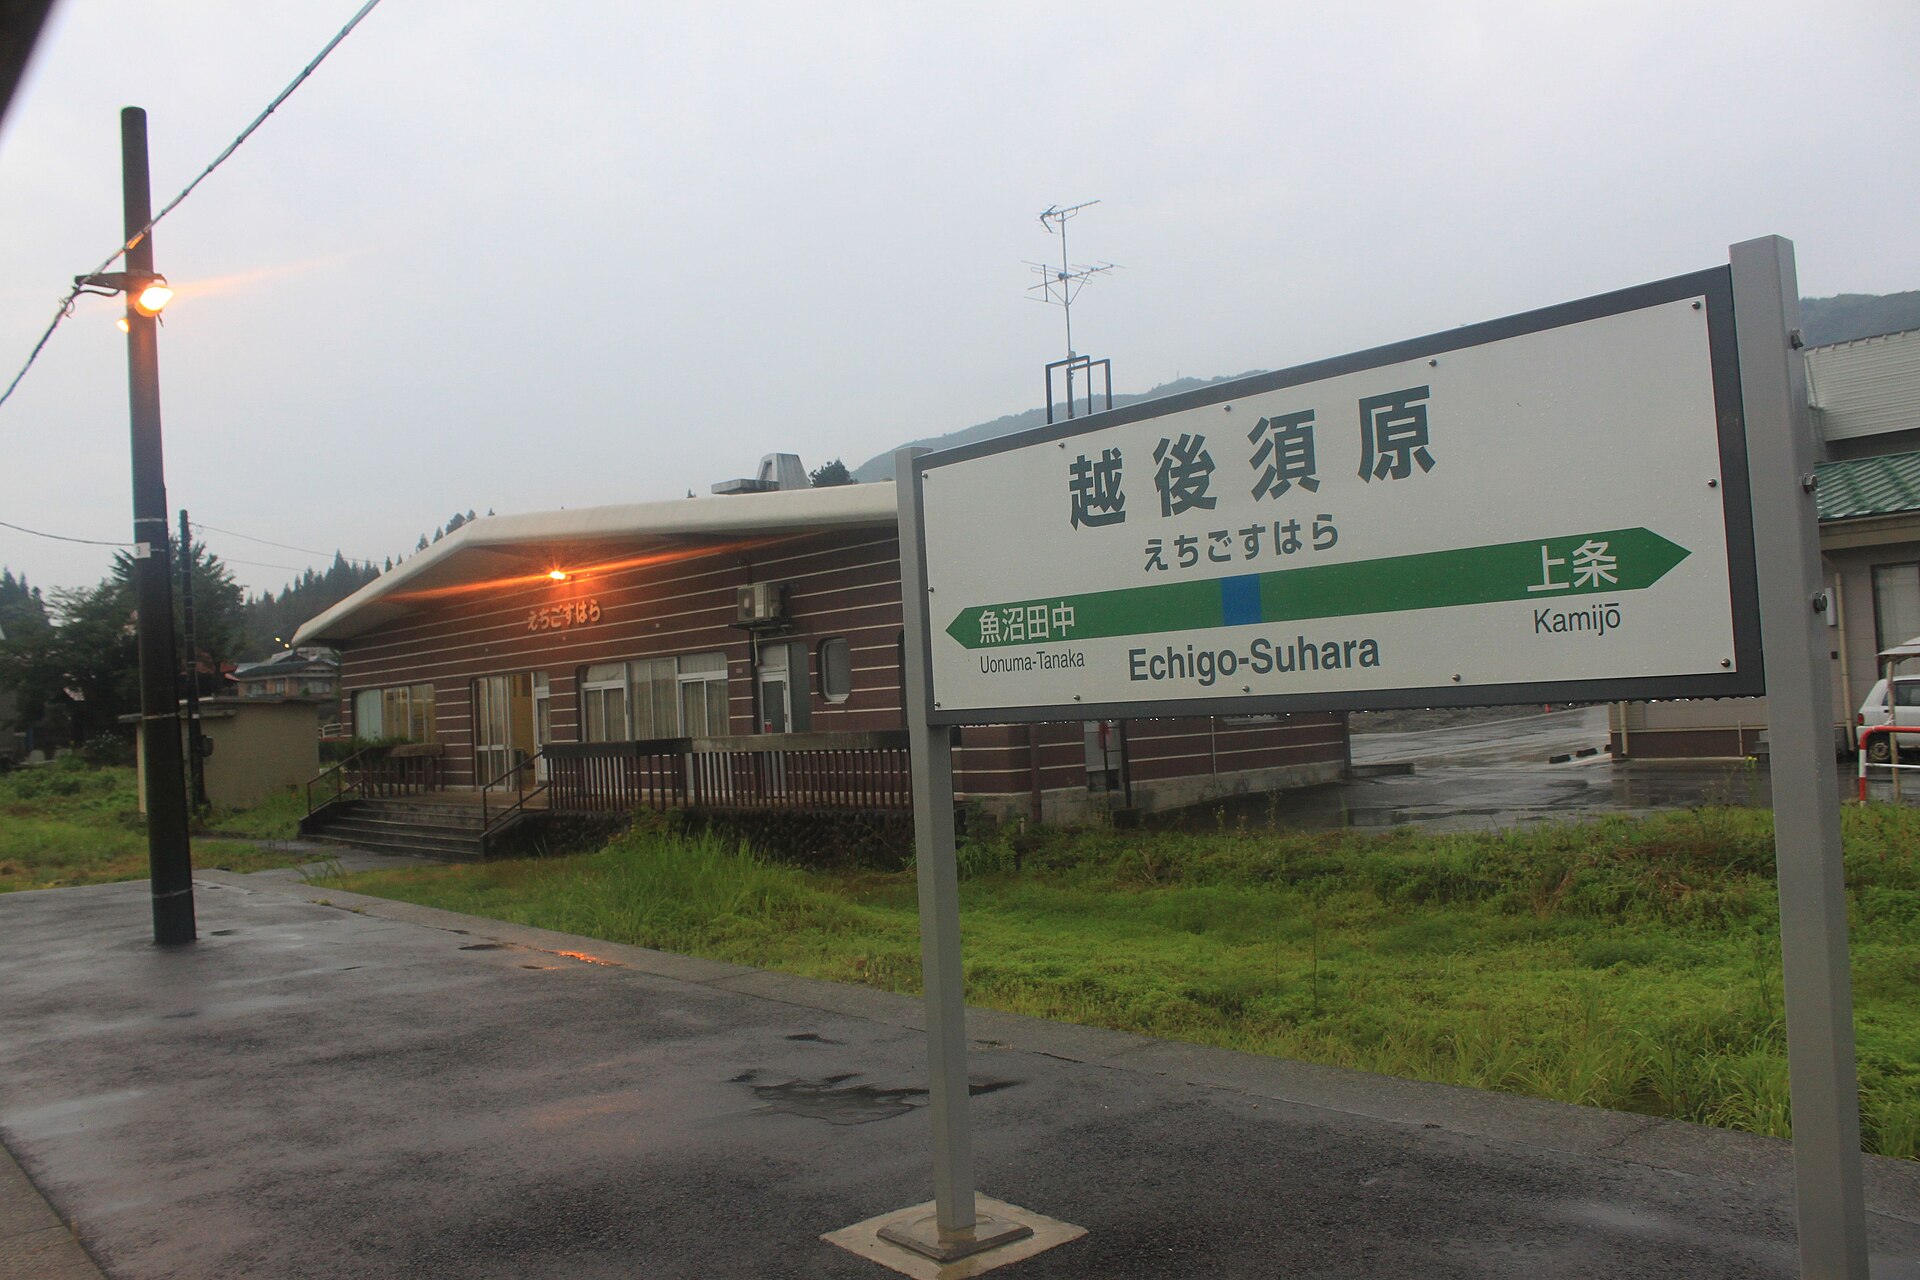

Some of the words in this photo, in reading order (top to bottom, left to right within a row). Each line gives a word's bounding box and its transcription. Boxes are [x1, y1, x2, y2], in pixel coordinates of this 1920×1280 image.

[1069, 384, 1436, 531] 越後須原
[1144, 513, 1339, 572] えちごすはら
[1527, 539, 1618, 592] 上条
[527, 599, 601, 631] えちごすはら
[979, 601, 1075, 643] 魚沼田中
[1533, 602, 1621, 636] Kamijō
[980, 648, 1085, 674] Uonuma-Tanaka
[1128, 636, 1380, 687] Echigo-Suhara
